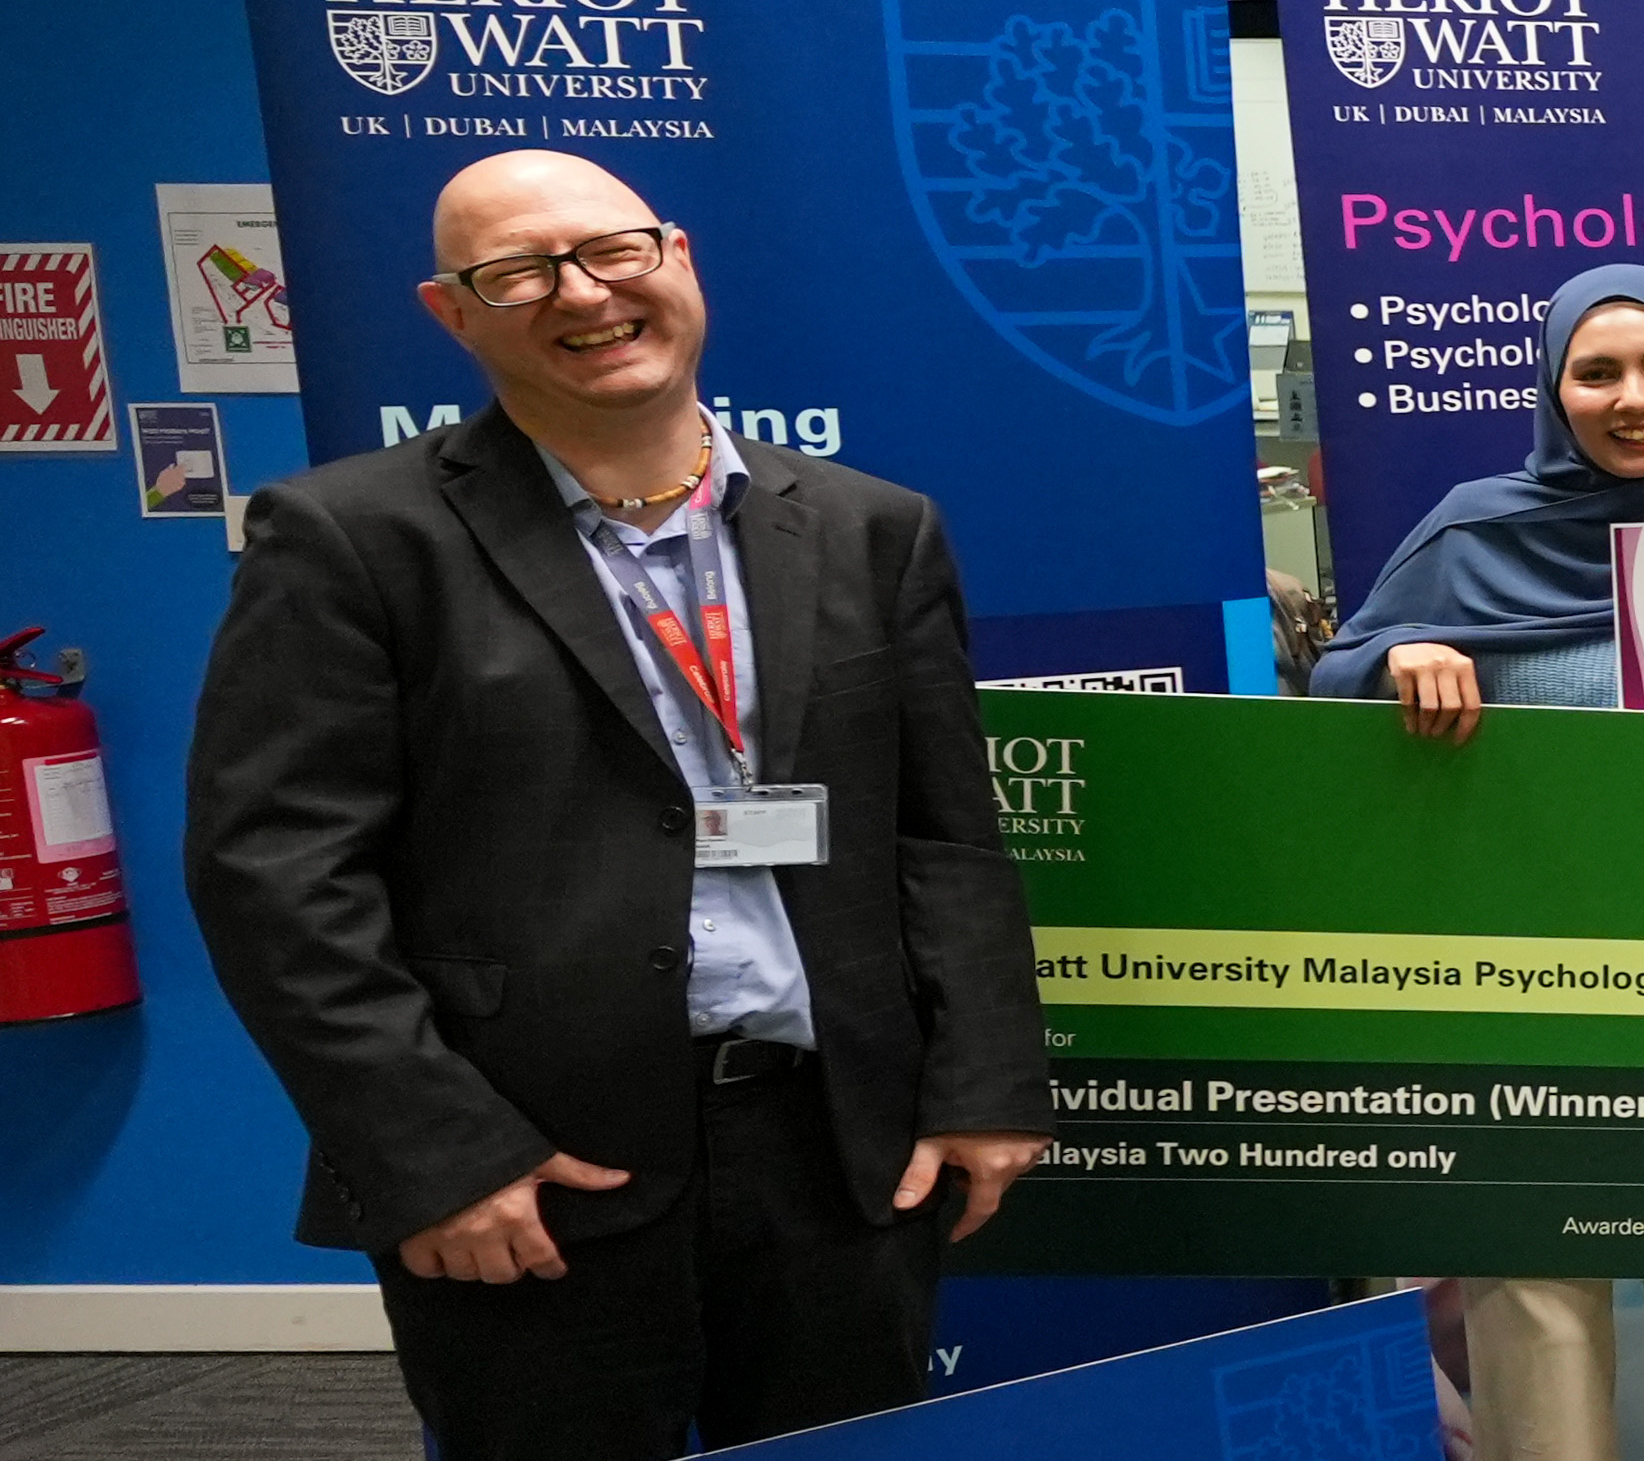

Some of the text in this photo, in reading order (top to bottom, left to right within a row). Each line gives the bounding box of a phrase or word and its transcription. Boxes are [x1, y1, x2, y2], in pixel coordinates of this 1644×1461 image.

[439, 11, 705, 72] WATT
[1406, 17, 1601, 68] WATT
[449, 71, 708, 99] UNIVERSITY
[1412, 67, 1603, 93] UNIVERSITY
[341, 115, 715, 140] UK DUBAI MALAYSIA
[1332, 105, 1607, 125] UK DUBAI MALAYSIA
[0, 282, 57, 313] IRE
[1389, 382, 1538, 415] Busines
[1101, 953, 1291, 989] University
[1304, 956, 1462, 992] Malaysia
[1045, 1028, 1077, 1049] for
[1051, 1079, 1194, 1114] ividual
[1208, 1080, 1477, 1118] Presentation
[1157, 1141, 1457, 1175] Two Hundred only
